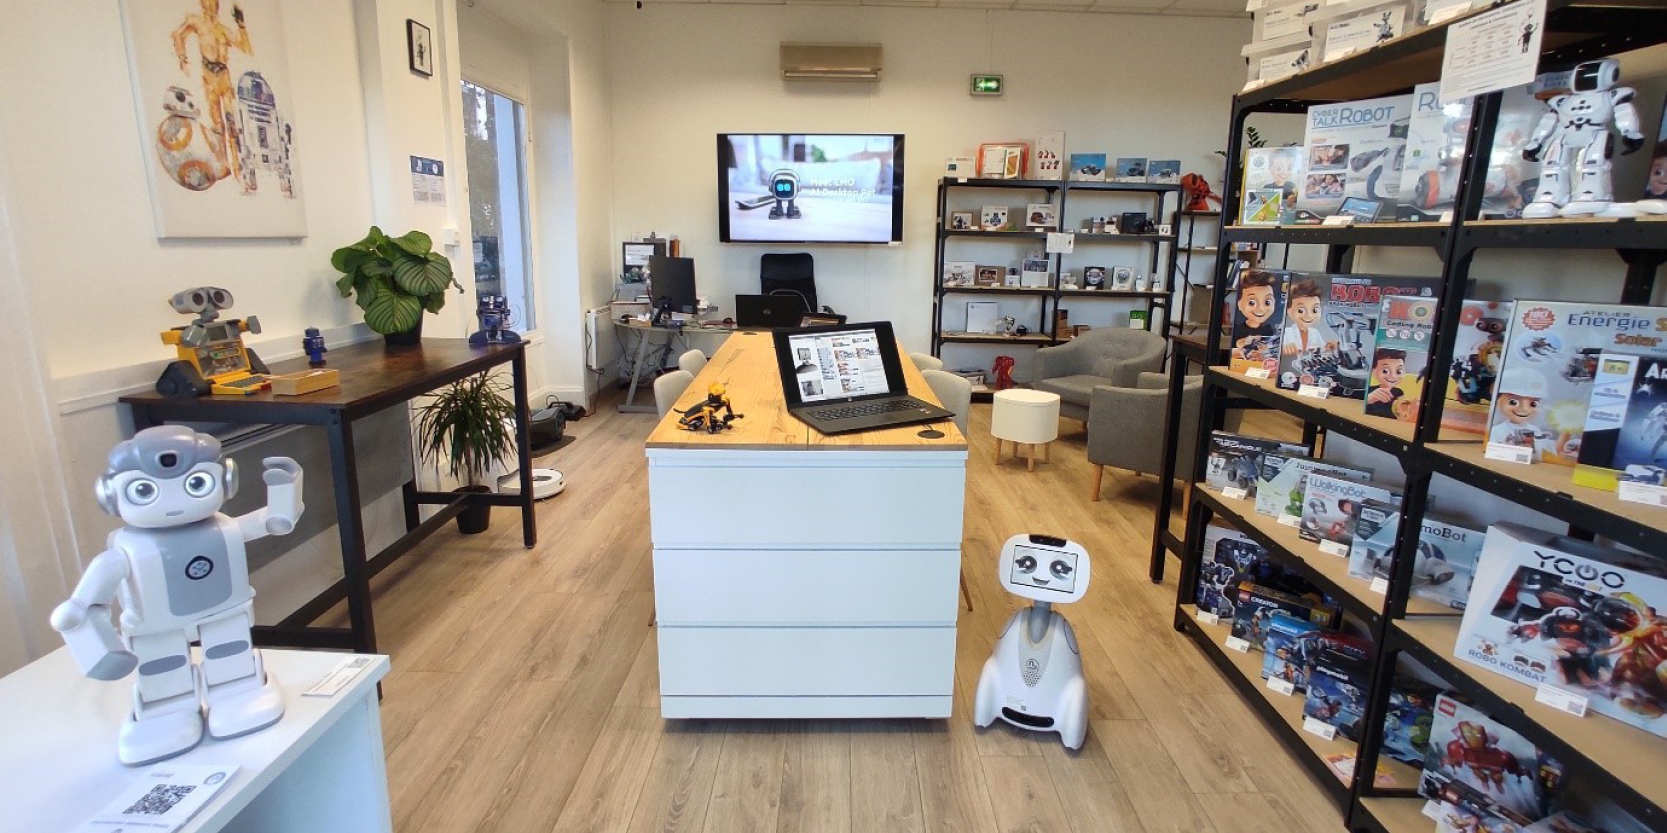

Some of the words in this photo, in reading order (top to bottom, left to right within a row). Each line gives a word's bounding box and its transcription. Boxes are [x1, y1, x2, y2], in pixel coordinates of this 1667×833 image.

[1312, 115, 1339, 127] TALK
[1339, 106, 1395, 123] ROBOT
[834, 178, 855, 186] EMO
[1386, 320, 1414, 329] Coding
[1567, 313, 1650, 331] Energie
[1614, 333, 1663, 347] Solar
[1309, 477, 1366, 499] WalkingBot
[1250, 596, 1279, 608] CREATOR
[1468, 649, 1498, 665] ROBO
[1500, 660, 1547, 682] KOMBAT
